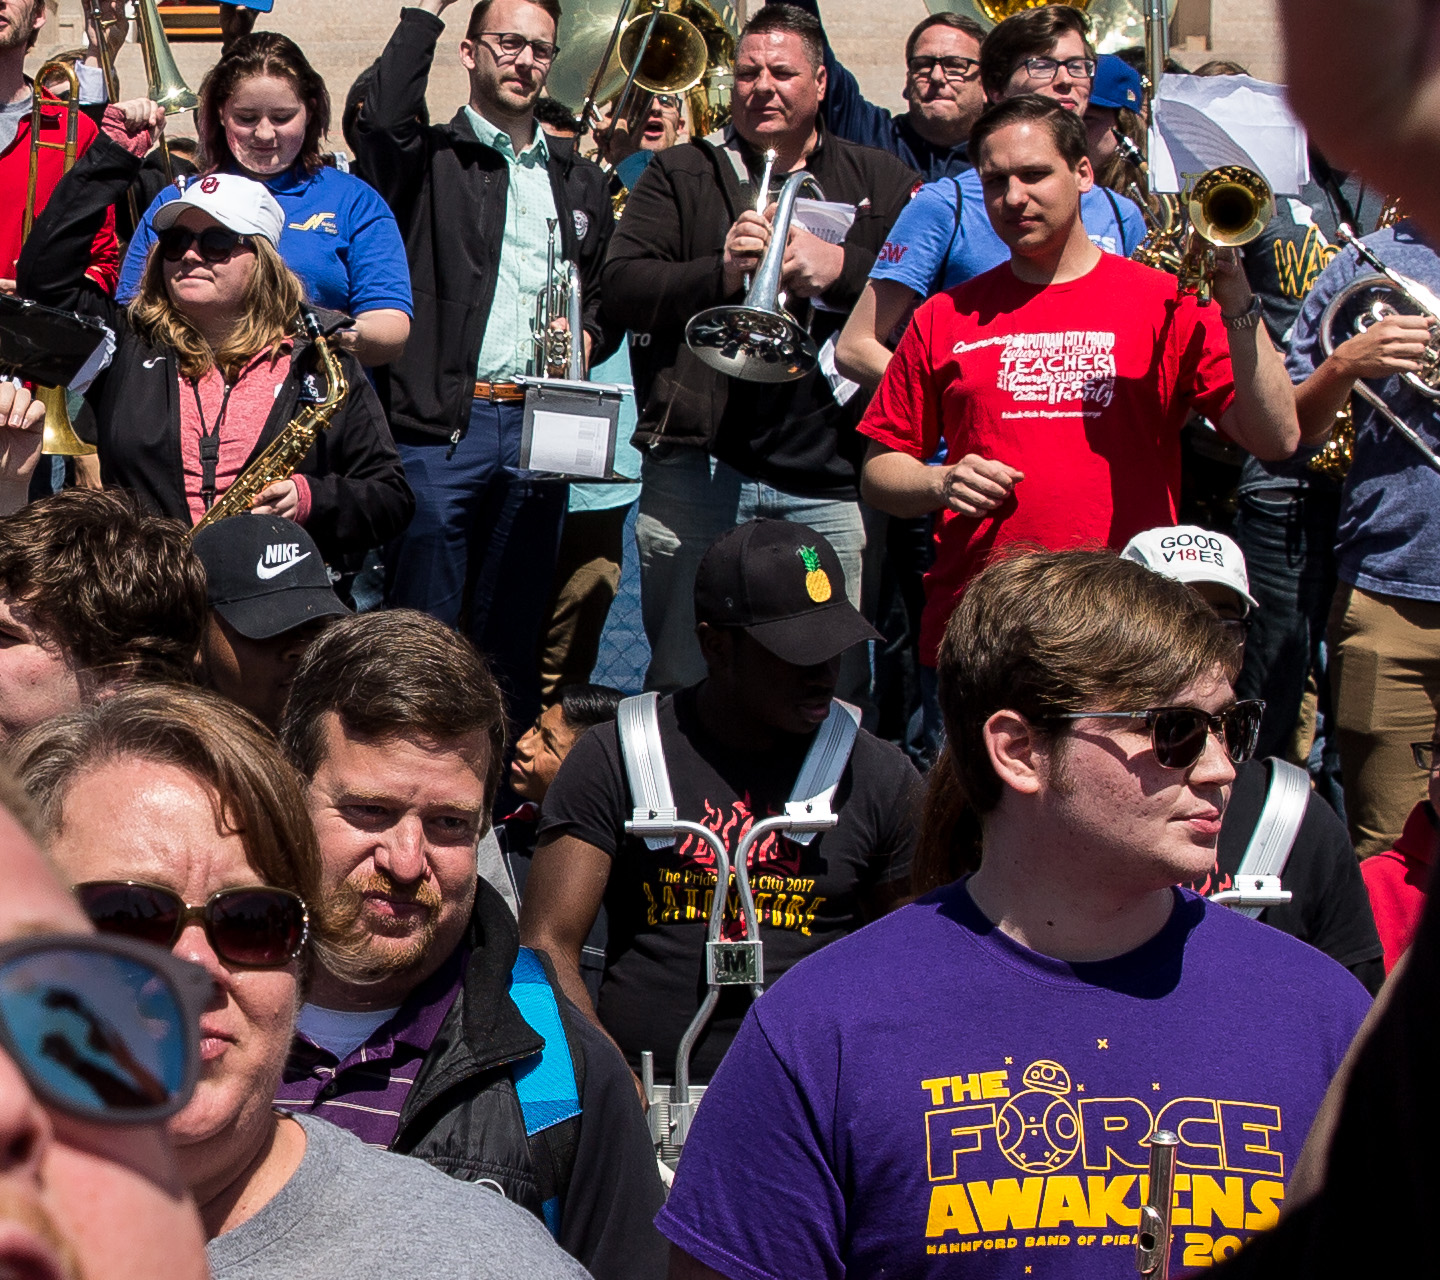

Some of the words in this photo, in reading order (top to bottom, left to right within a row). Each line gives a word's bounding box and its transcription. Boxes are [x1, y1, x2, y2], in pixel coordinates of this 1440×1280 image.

[200, 176, 220, 194] OU
[1274, 224, 1342, 298] WA
[1029, 332, 1064, 350] PUTNAM
[1064, 331, 1086, 348] CITY
[1085, 331, 1116, 348] PROUD
[1000, 346, 1041, 359] Future
[1000, 353, 1110, 374] TEACHER
[1054, 370, 1110, 384] SUPPORT
[1160, 534, 1222, 552] GOOD
[265, 543, 300, 565] NIKE
[1162, 548, 1225, 568] V18ES
[659, 868, 681, 884] The
[684, 869, 719, 886] Pride
[759, 875, 784, 893] City
[786, 877, 816, 893] 2017
[921, 1069, 1009, 1107] THE
[925, 1089, 1284, 1182] FORCE
[1024, 1234, 1071, 1248] BAND
[1077, 1234, 1096, 1247] OF
[1183, 1233, 1253, 1268] 20
